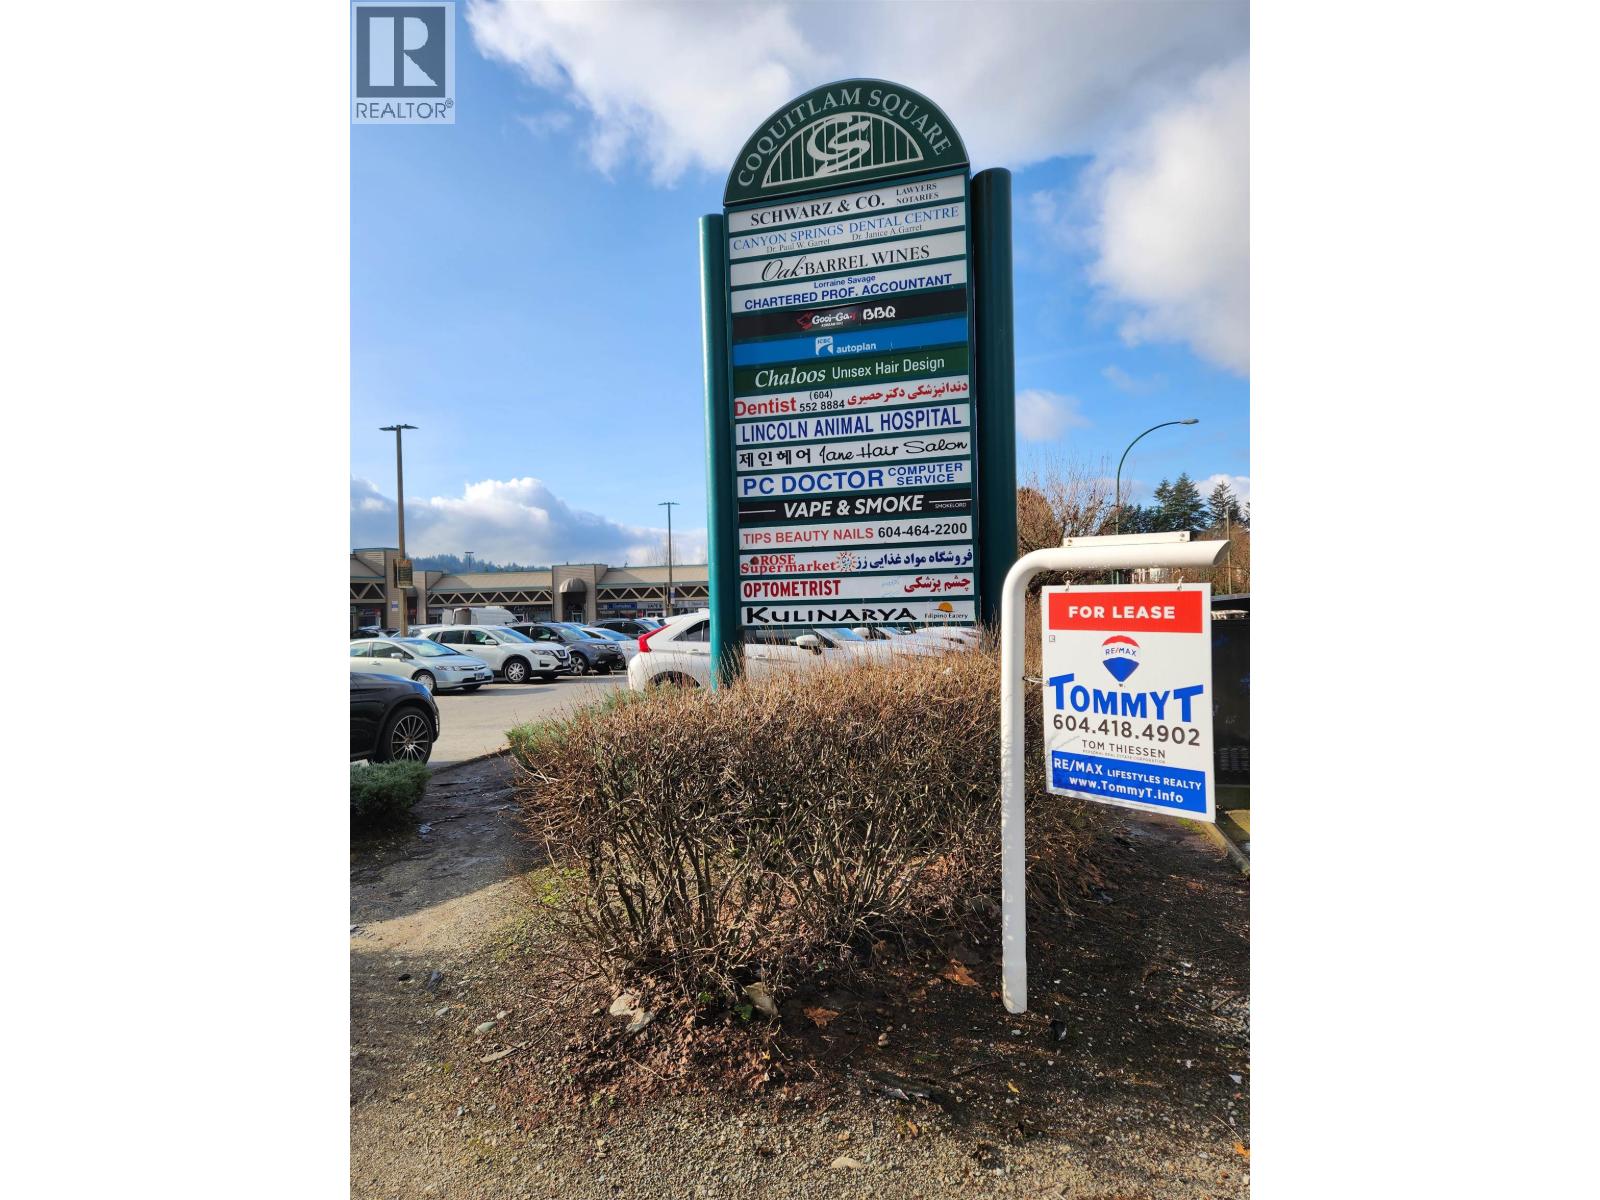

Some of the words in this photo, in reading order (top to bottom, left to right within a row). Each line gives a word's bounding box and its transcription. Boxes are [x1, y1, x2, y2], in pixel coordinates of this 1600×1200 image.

[738, 87, 861, 187] COQUITLAM
[867, 89, 952, 156] SQUARE
[896, 183, 937, 196] LAWYERS
[896, 192, 939, 205] NOTARIES
[750, 201, 833, 227] SCHWARZ
[837, 199, 850, 213] &
[855, 194, 885, 209] CO.
[733, 232, 787, 251] CANYON
[790, 223, 844, 242] SPRINGS
[849, 215, 902, 233] DENTAL
[904, 206, 959, 224] CENTRE
[865, 229, 888, 239] Janice
[761, 256, 806, 281] Oak
[805, 254, 868, 275] BARREL
[872, 245, 930, 265] WINES
[814, 278, 846, 288] Lorraine
[847, 275, 876, 284] Savage
[744, 292, 818, 310] CHARTERED
[821, 286, 858, 300] PROF.
[861, 273, 952, 296] ACCOUNTANT
[863, 305, 896, 320] BBQ
[836, 342, 877, 354] autoplan
[755, 366, 826, 388] Chaloos
[875, 360, 899, 375] Hair
[903, 357, 945, 372] Design
[809, 389, 833, 400] (604)
[735, 397, 796, 416] Dentist
[800, 402, 818, 412] 552
[820, 400, 845, 411] 8884
[742, 420, 808, 443] LINCOLN
[814, 415, 874, 437] ANIMAL
[880, 406, 962, 431] HOSPITAL
[819, 445, 855, 464] Jane
[856, 442, 899, 459] Hair
[903, 438, 967, 454] Salon
[888, 462, 963, 477] COMPUTER
[743, 476, 775, 495] PC
[781, 469, 884, 493] DOCTOR
[896, 473, 955, 486] SERVICE
[783, 500, 832, 518] VAPE
[836, 499, 851, 516] &
[854, 494, 924, 515] SMOKE
[743, 532, 772, 544] TIPS
[775, 529, 829, 543] BEAUTY
[833, 527, 874, 540] NAILS
[878, 522, 967, 538] 604-464-2200
[740, 560, 837, 575] Supermarket
[760, 554, 796, 566] ROSE
[743, 579, 841, 598] OPTOMETRIST
[746, 607, 917, 624] KULINARYA
[1068, 605, 1105, 619] FOR
[1112, 605, 1176, 619] LEASE
[1105, 647, 1137, 657] RE/MAX
[1053, 714, 1201, 747] 604.418.4902
[1082, 739, 1105, 751] TOM
[1109, 743, 1166, 759] THIESSEN
[1054, 757, 1103, 775] RE/MAX
[1107, 769, 1161, 785] LIFESTYLES
[1163, 777, 1202, 791] REALTY
[1069, 776, 1184, 803] www.TommyT.info
